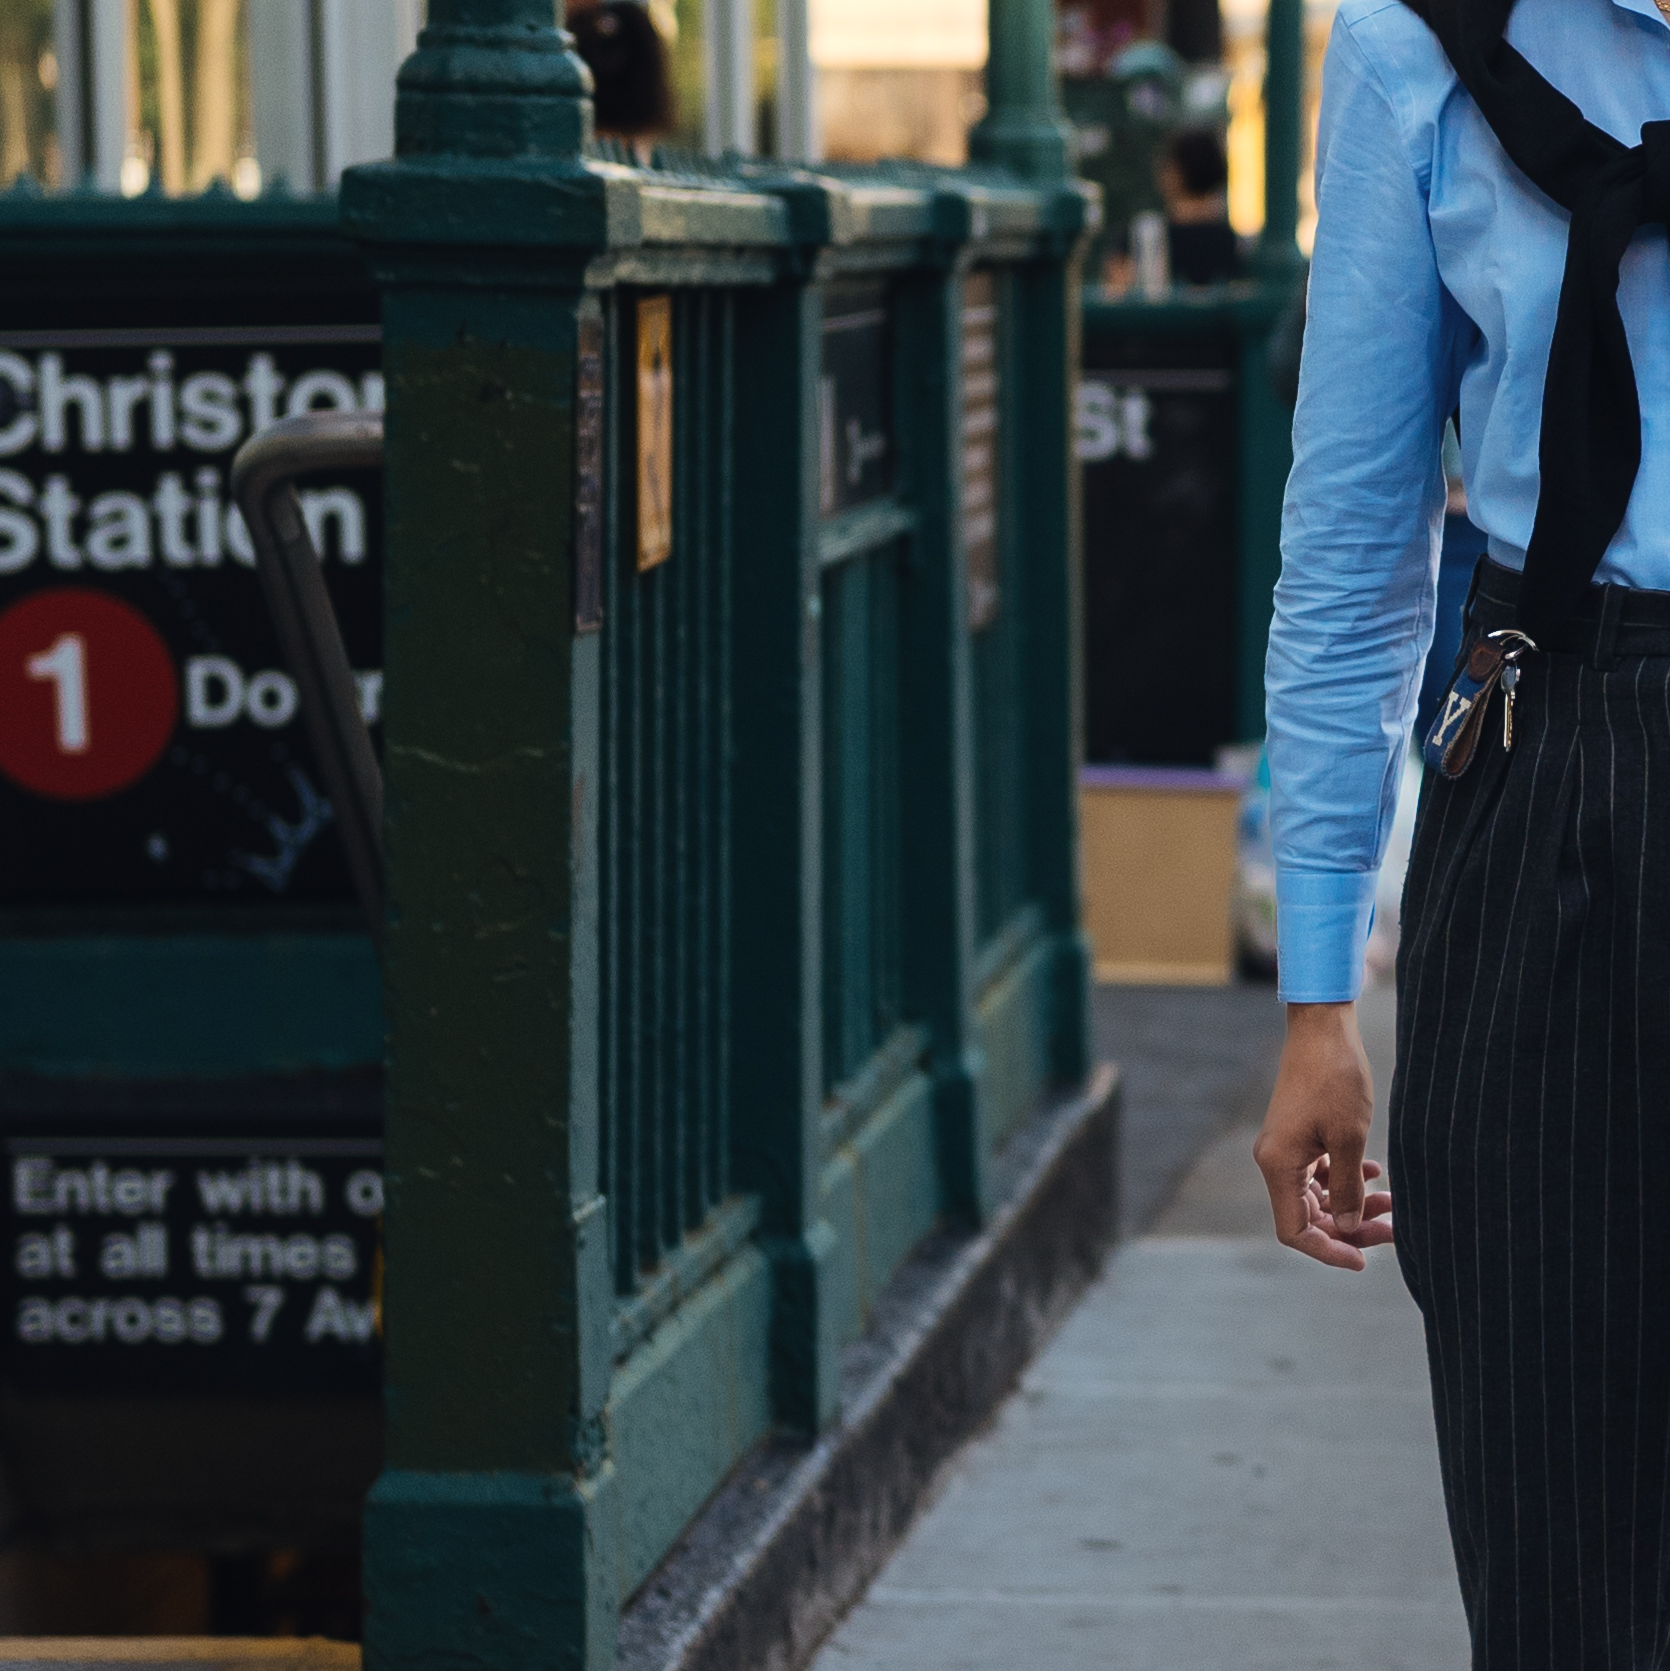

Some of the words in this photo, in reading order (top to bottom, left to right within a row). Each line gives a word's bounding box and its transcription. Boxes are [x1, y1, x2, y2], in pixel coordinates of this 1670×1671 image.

[0, 349, 384, 456] Christo
[25, 631, 90, 754] 1
[1432, 691, 1472, 746] Y
[13, 1157, 175, 1216] Enter
[196, 1158, 324, 1216] with
[16, 1222, 76, 1280] at
[99, 1221, 168, 1280] all
[190, 1221, 358, 1280] times
[16, 1296, 223, 1344] across
[242, 1285, 285, 1344] 7
